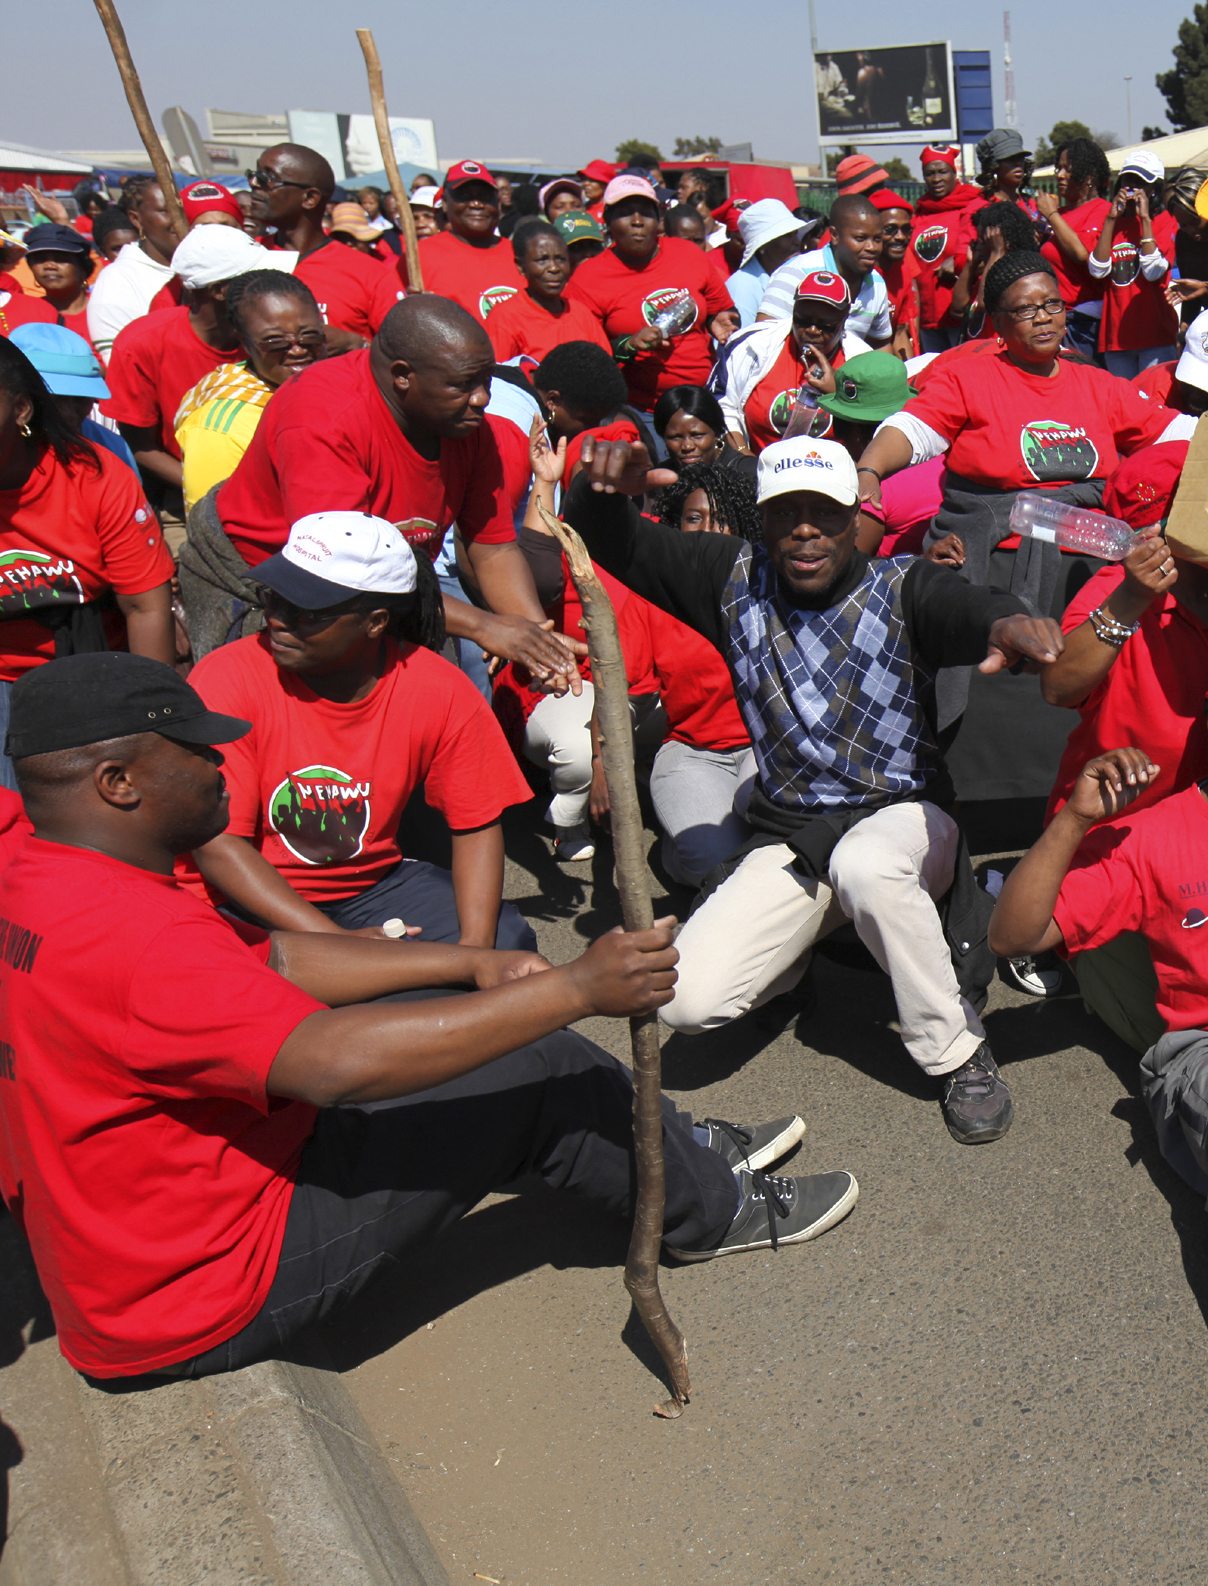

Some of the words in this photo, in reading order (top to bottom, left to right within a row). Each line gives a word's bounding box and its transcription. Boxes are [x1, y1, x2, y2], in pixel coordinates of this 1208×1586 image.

[1032, 427, 1086, 441] NEHAWU
[774, 457, 834, 474] ellesse
[293, 544, 323, 562] HOSPITAL
[0, 560, 74, 583] EHAWU
[297, 782, 370, 799] NEHAWU
